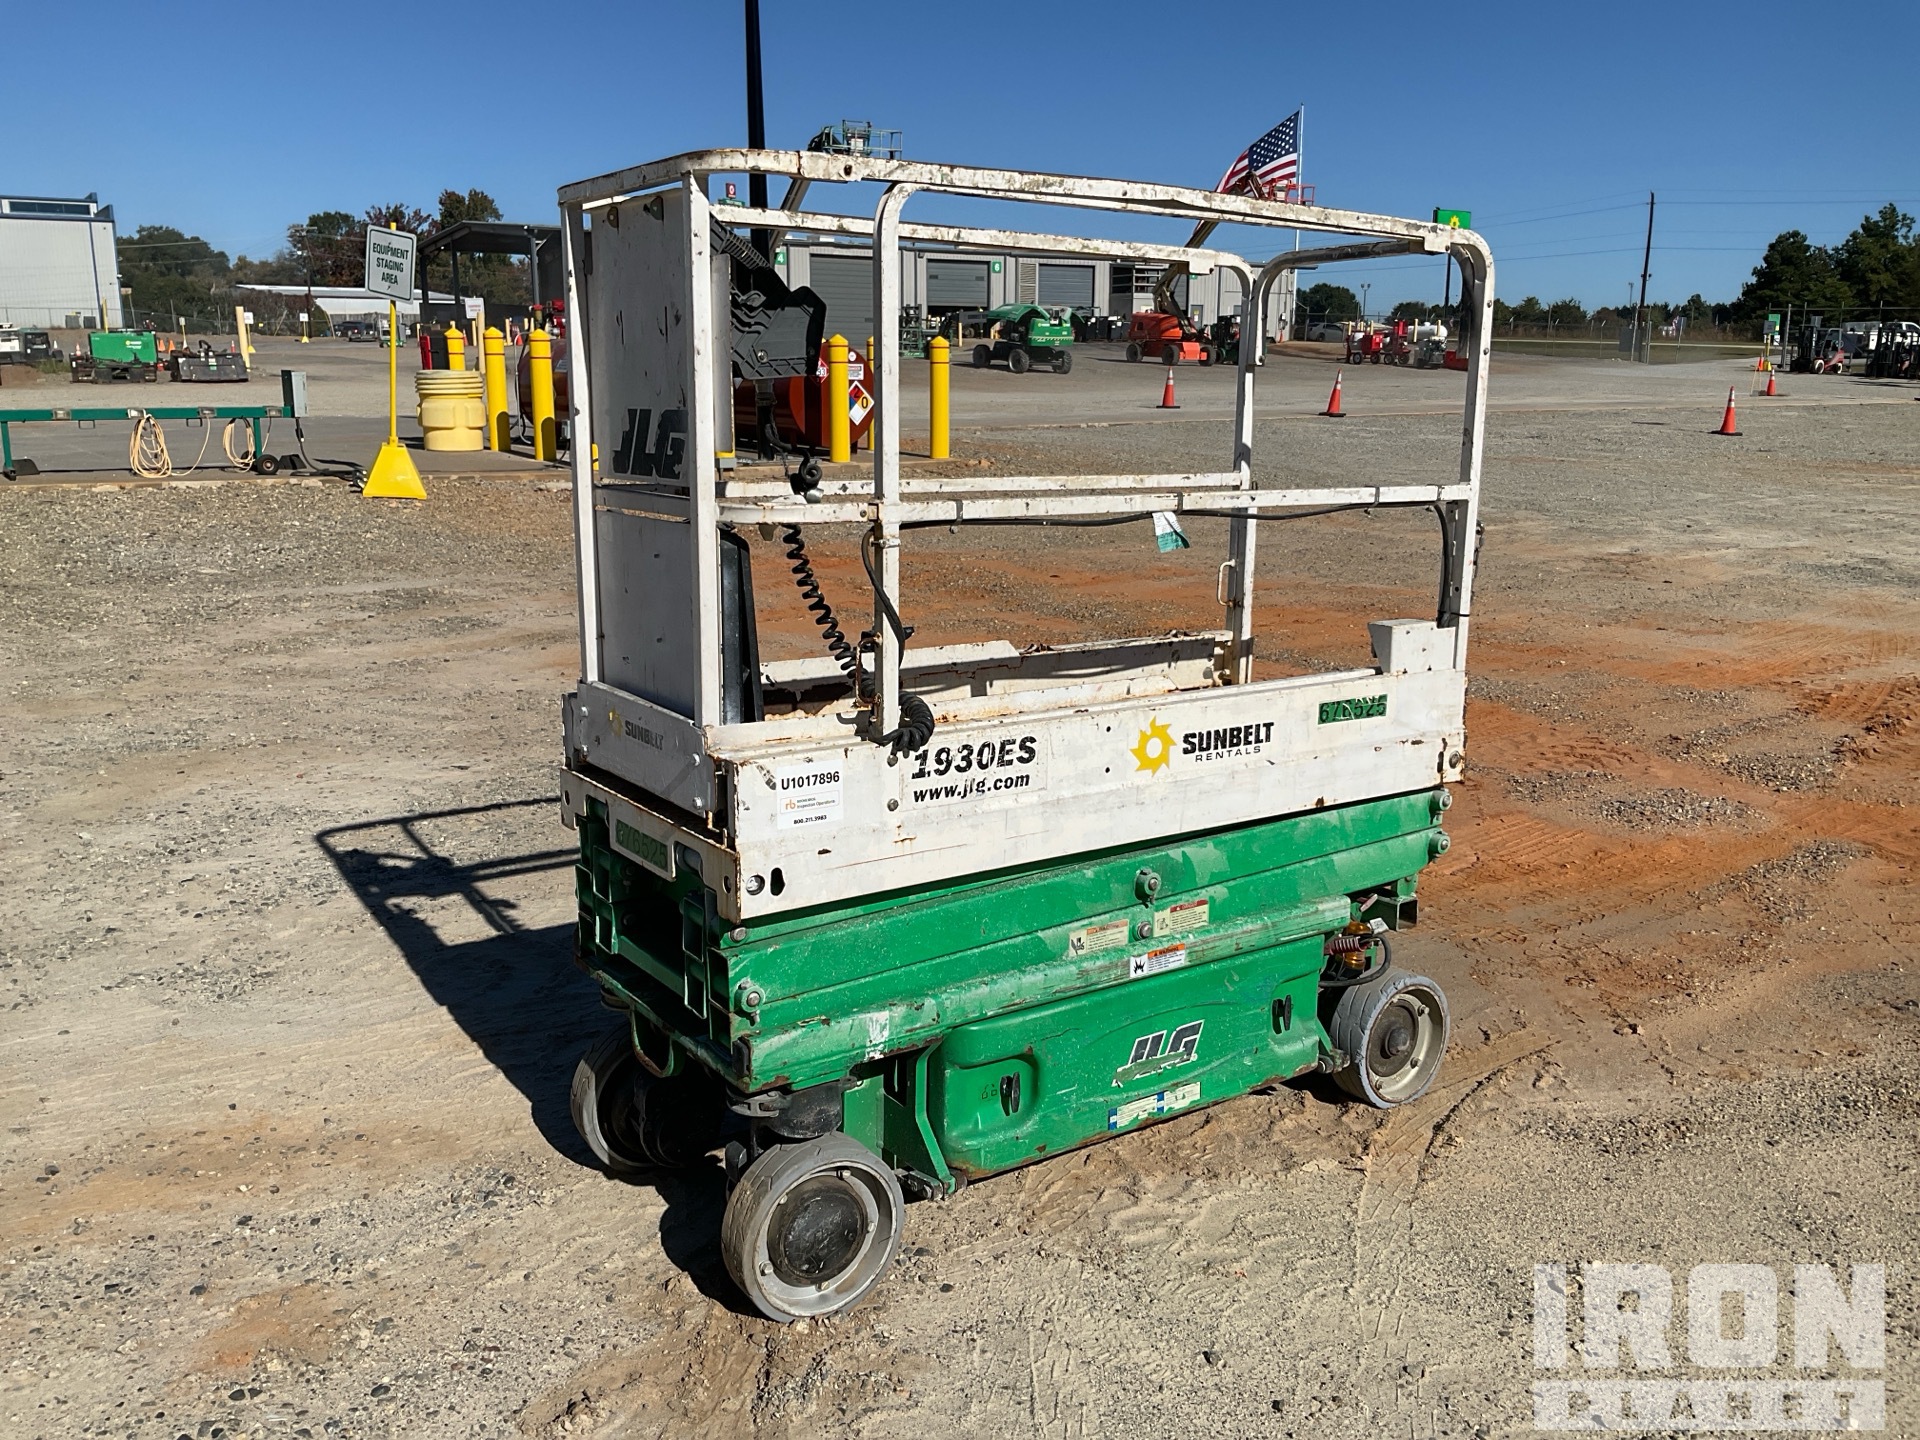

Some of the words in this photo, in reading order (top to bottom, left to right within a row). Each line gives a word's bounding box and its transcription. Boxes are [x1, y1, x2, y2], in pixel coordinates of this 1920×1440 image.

[372, 242, 410, 260] EQUIPMENT
[777, 255, 784, 263] 4
[376, 257, 404, 273] STAGING
[994, 263, 1000, 272] 6
[381, 272, 399, 286] AREA
[861, 396, 869, 410] 0
[612, 408, 689, 480] JLG
[625, 720, 664, 751] SUNBELT
[1182, 722, 1274, 755] SUNBELT
[911, 736, 1037, 779] 1930ES
[1195, 745, 1261, 762] RENTALS
[781, 771, 840, 790] U1017896
[913, 774, 1031, 803] www.jlg.com
[785, 799, 796, 810] rb
[1111, 1018, 1205, 1088] JLG
